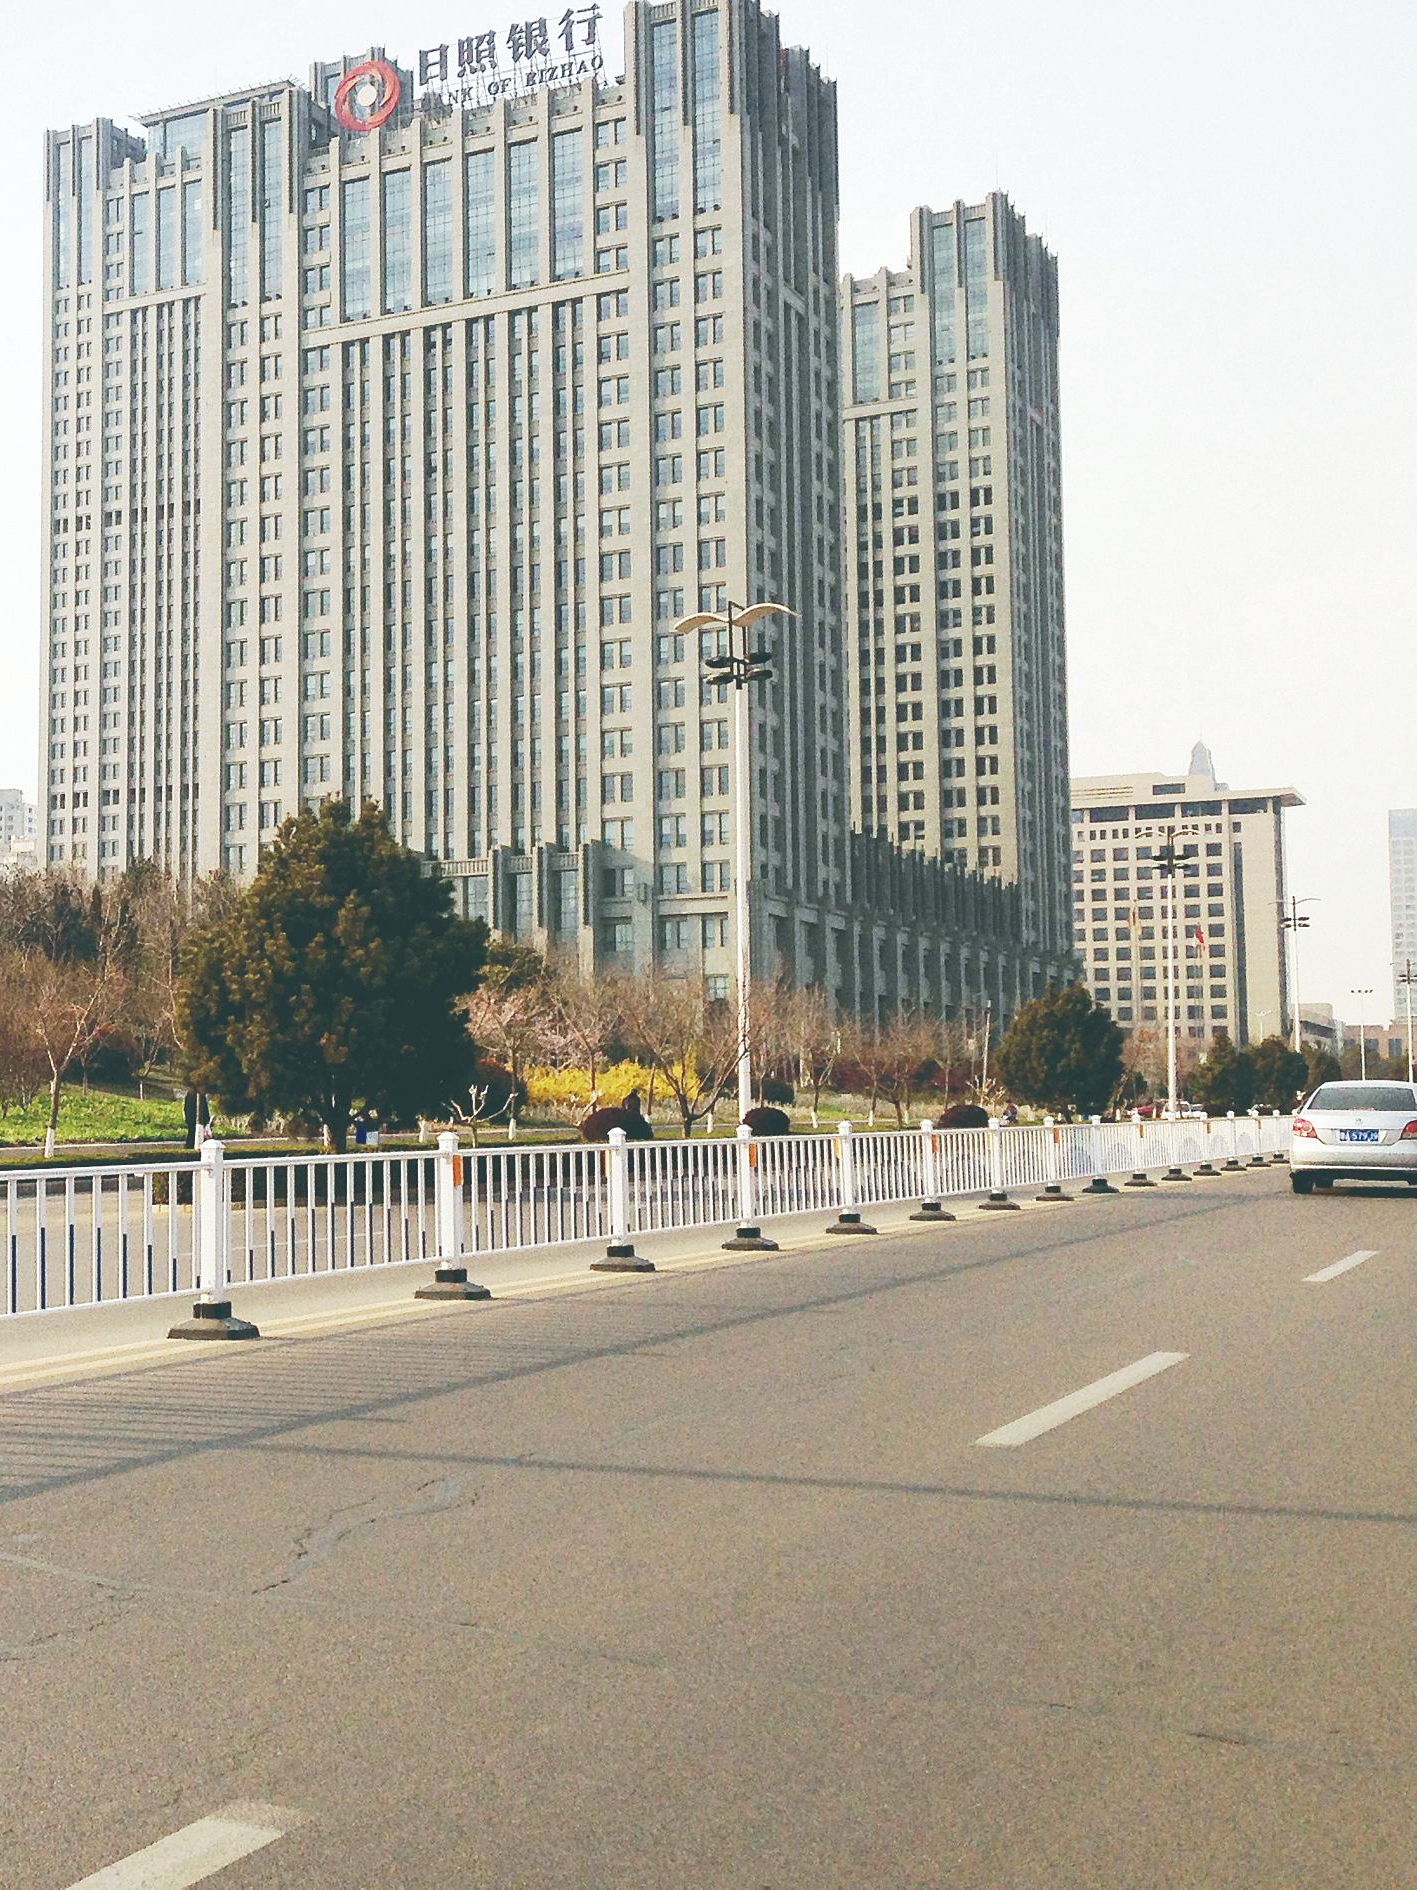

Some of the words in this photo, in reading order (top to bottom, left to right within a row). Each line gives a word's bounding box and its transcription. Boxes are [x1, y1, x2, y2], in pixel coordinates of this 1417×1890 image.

[419, 3, 603, 86] 日照银行
[488, 78, 512, 96] OF
